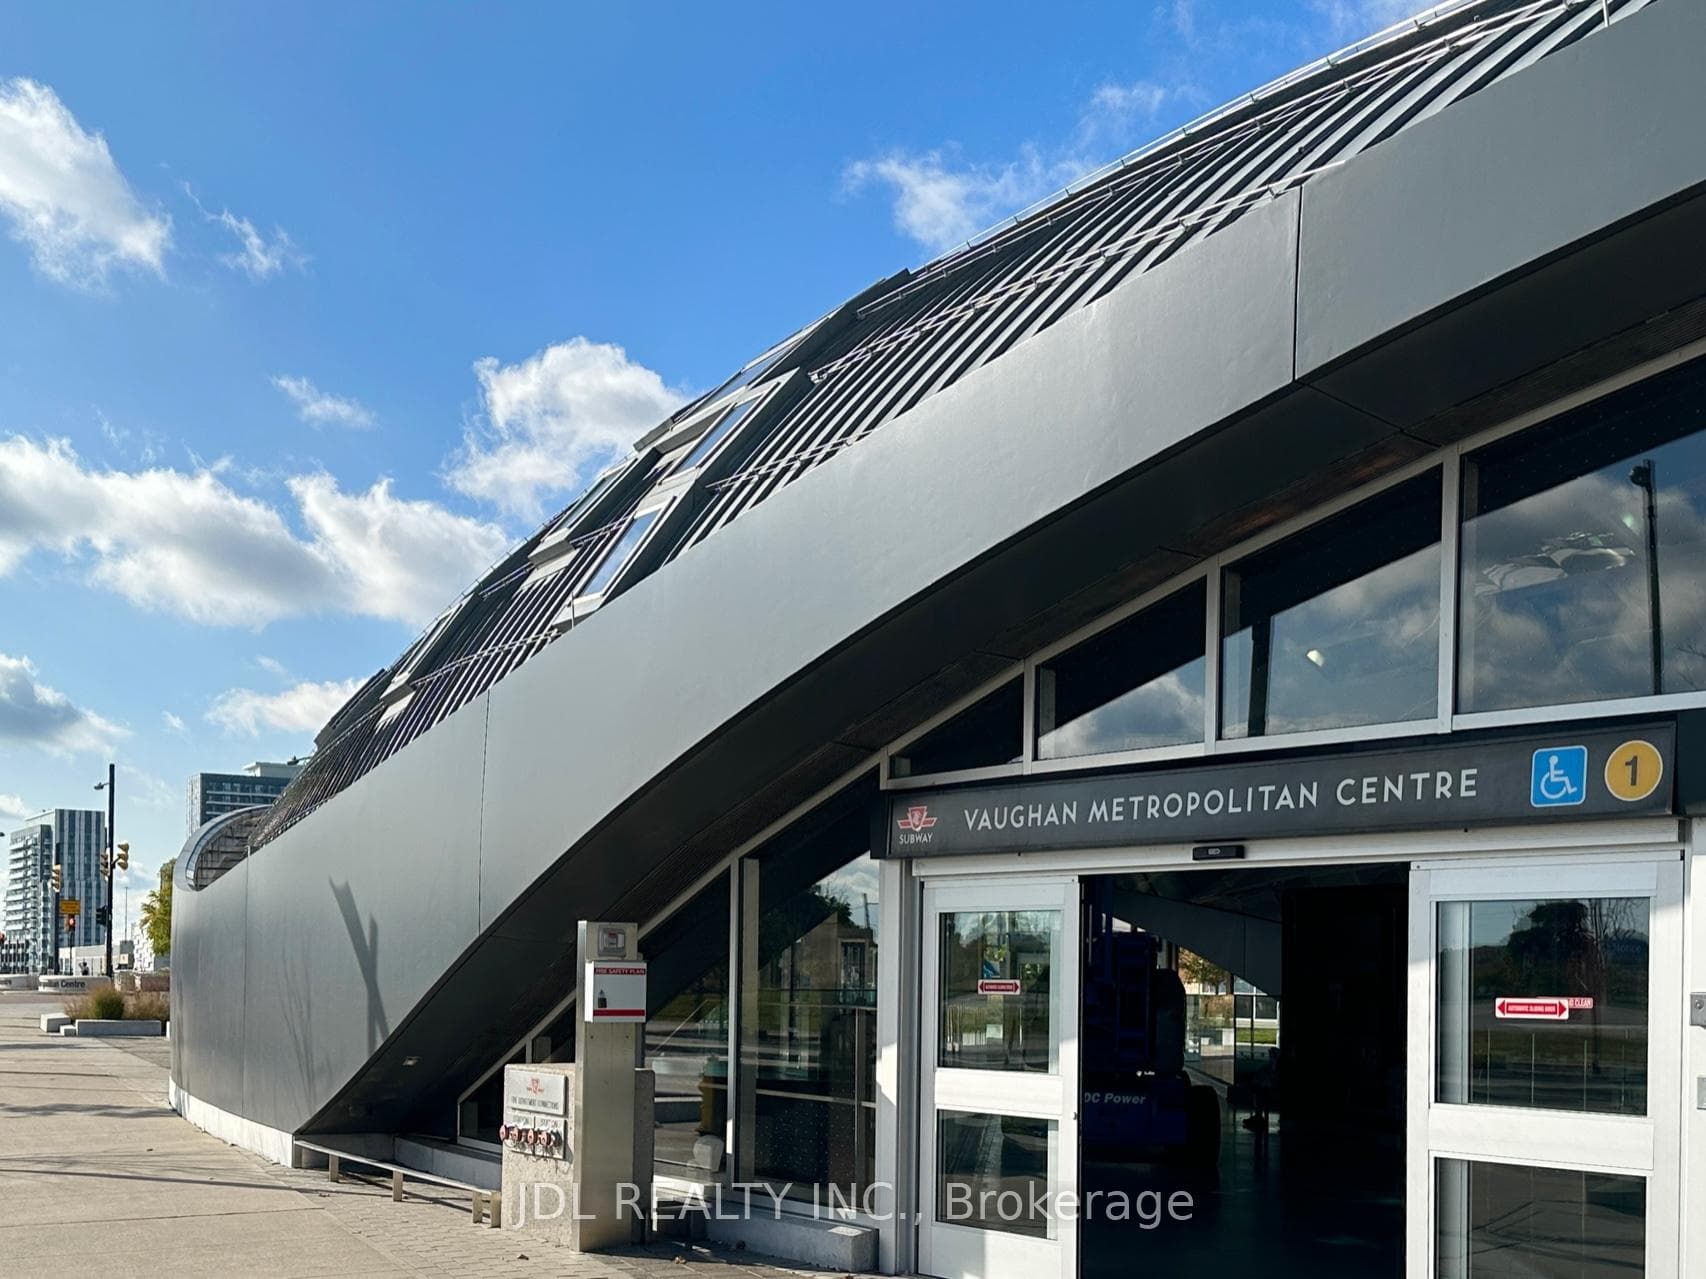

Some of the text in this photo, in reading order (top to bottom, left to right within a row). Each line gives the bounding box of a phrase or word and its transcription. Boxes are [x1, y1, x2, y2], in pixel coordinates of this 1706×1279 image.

[1625, 755, 1638, 786] 1
[964, 768, 1478, 831] VAUGHAN METROPOLITAN CENTRE
[899, 832, 934, 845] SUBWAY
[1104, 1092, 1146, 1104] Power
